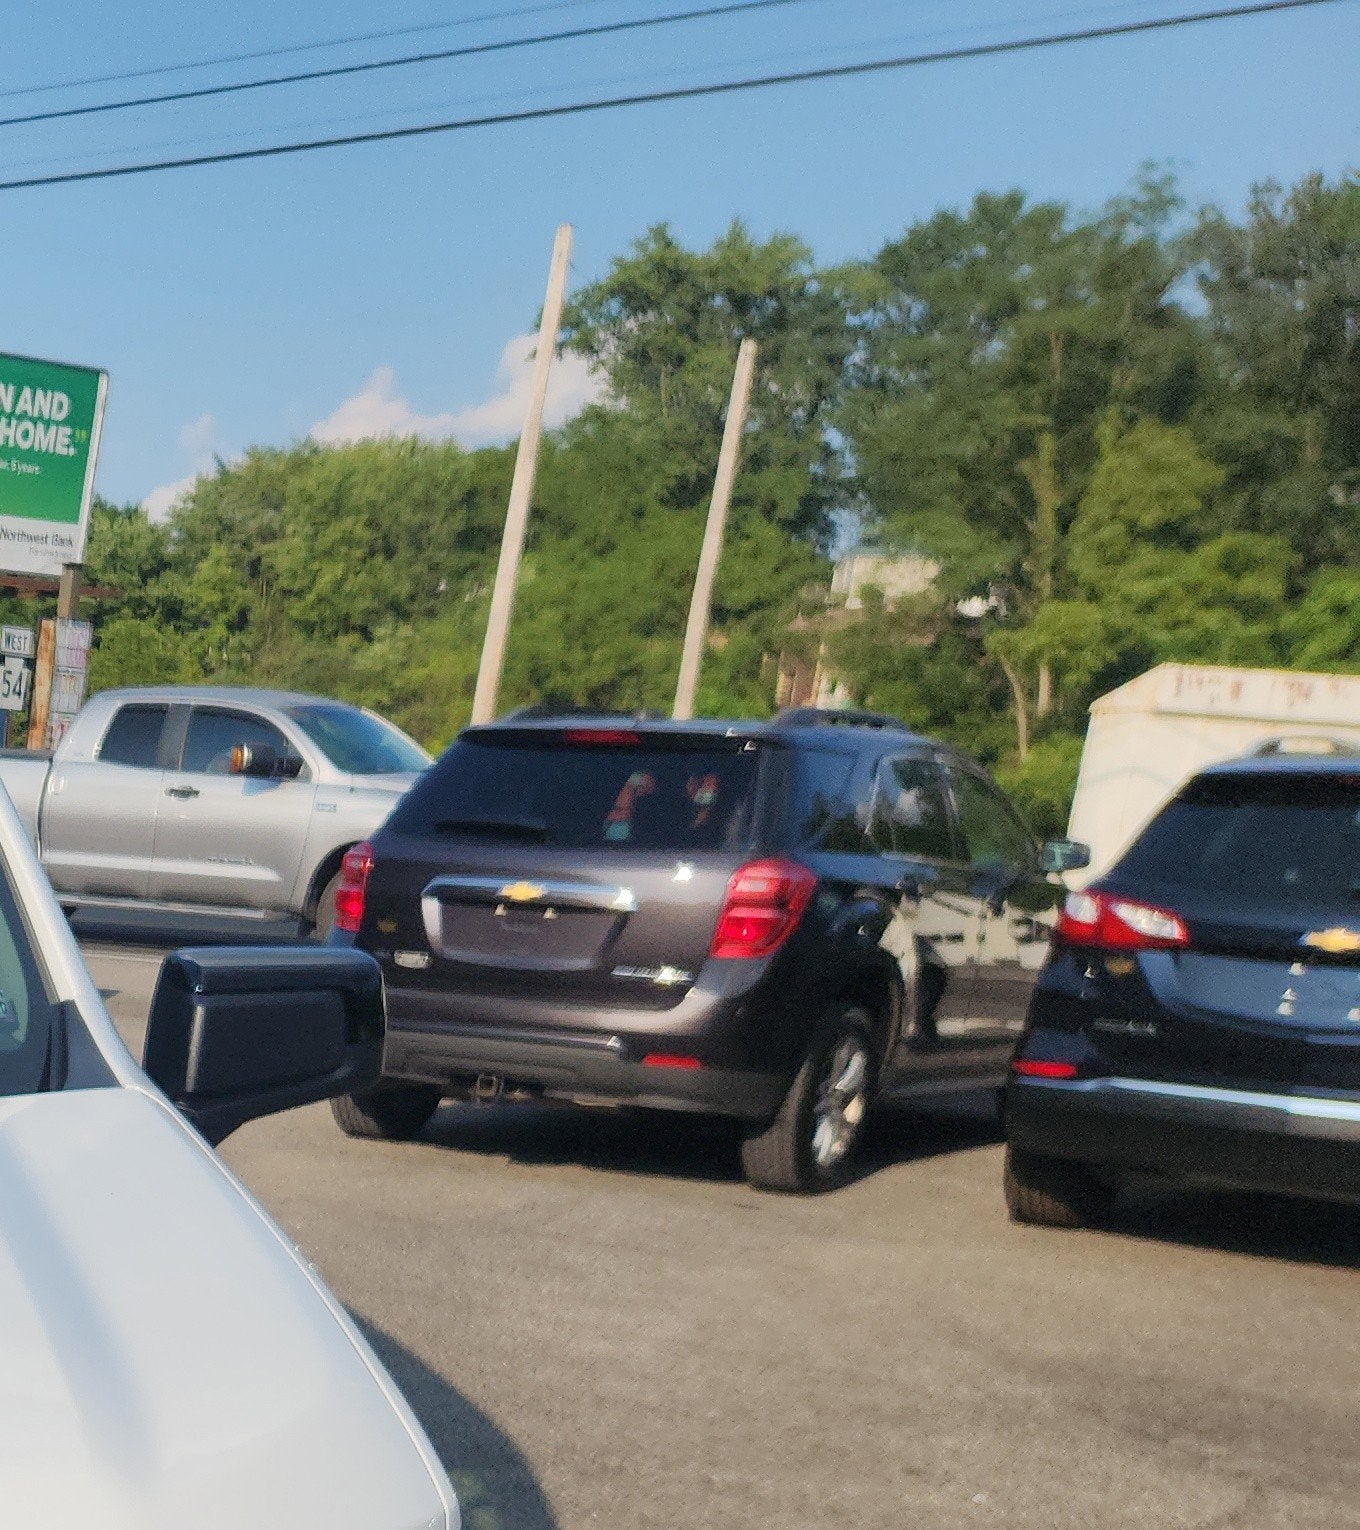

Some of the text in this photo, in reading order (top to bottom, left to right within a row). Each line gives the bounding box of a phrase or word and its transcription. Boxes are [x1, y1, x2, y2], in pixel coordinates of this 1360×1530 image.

[15, 386, 71, 421] AND
[0, 525, 49, 545] Northwest
[51, 533, 74, 548] Bank
[4, 632, 28, 651] WEST
[1, 669, 23, 698] 54
